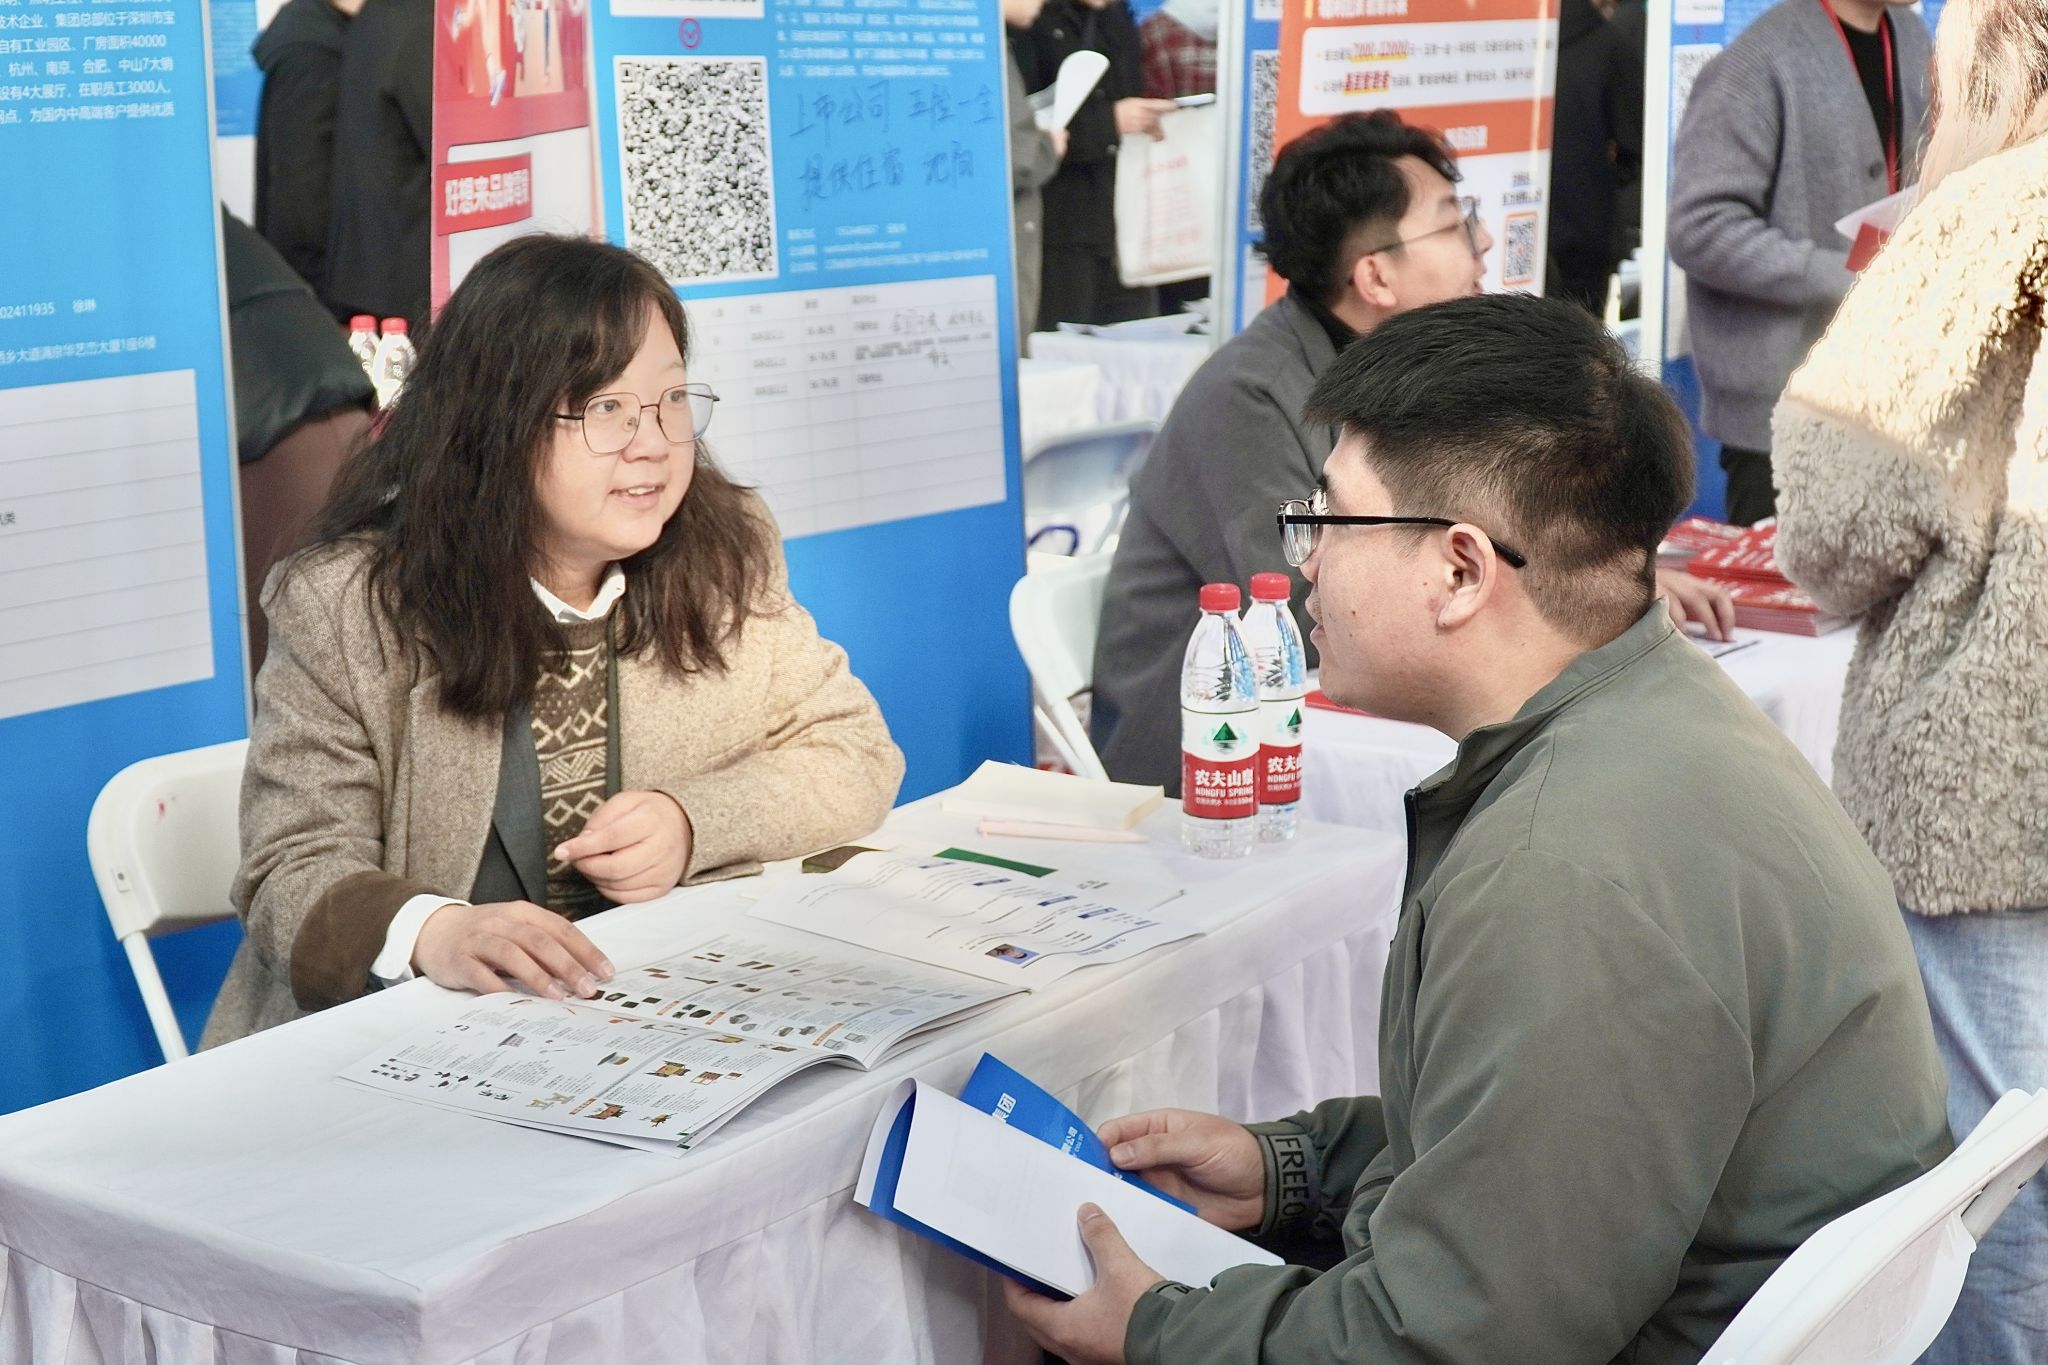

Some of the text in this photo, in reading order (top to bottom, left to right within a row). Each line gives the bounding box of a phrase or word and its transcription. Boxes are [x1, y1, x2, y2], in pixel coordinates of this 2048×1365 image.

[0, 301, 55, 320] 02411935
[1195, 768, 1254, 787] 农夫山泉
[1267, 772, 1296, 783] NONGFU
[1195, 787, 1226, 797] NONGFU
[1275, 1137, 1310, 1221] FREEO
